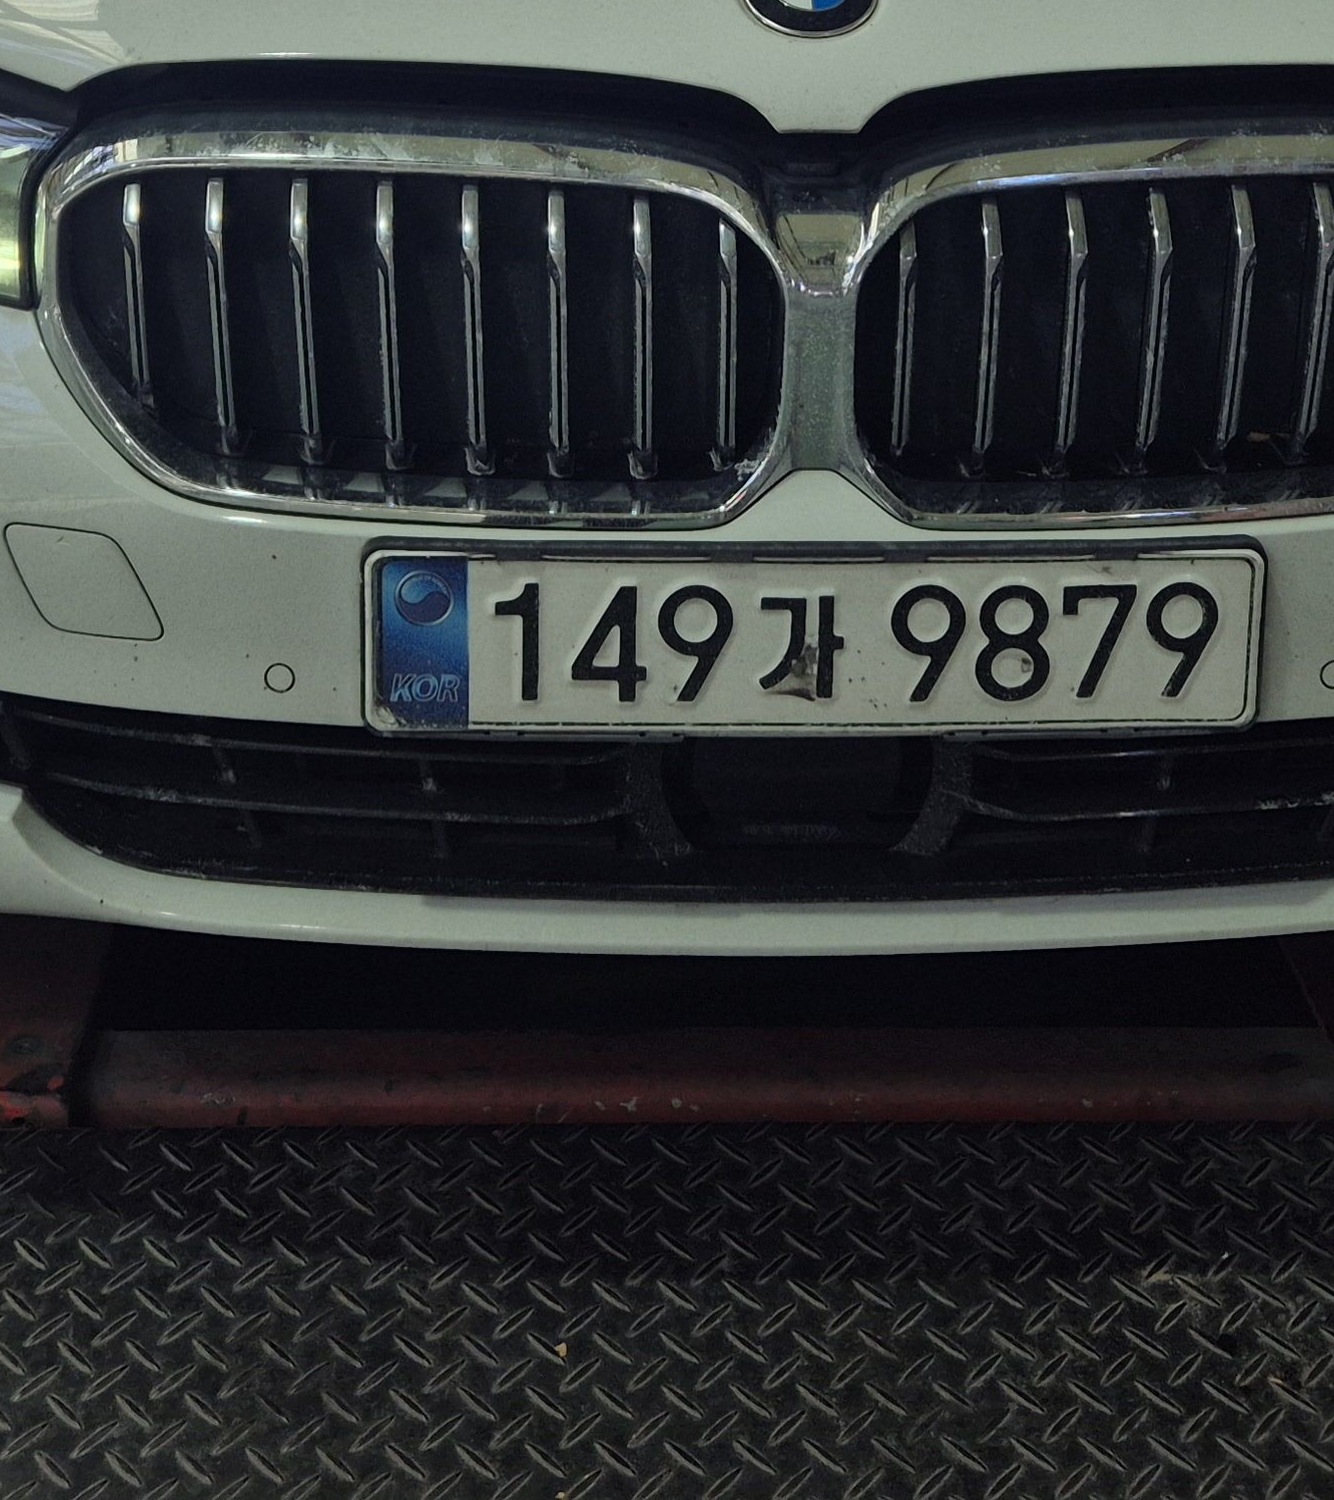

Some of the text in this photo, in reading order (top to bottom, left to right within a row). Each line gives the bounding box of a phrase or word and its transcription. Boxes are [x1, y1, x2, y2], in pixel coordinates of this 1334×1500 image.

[494, 581, 1219, 702] 149가 9879
[390, 673, 461, 703] KOR
